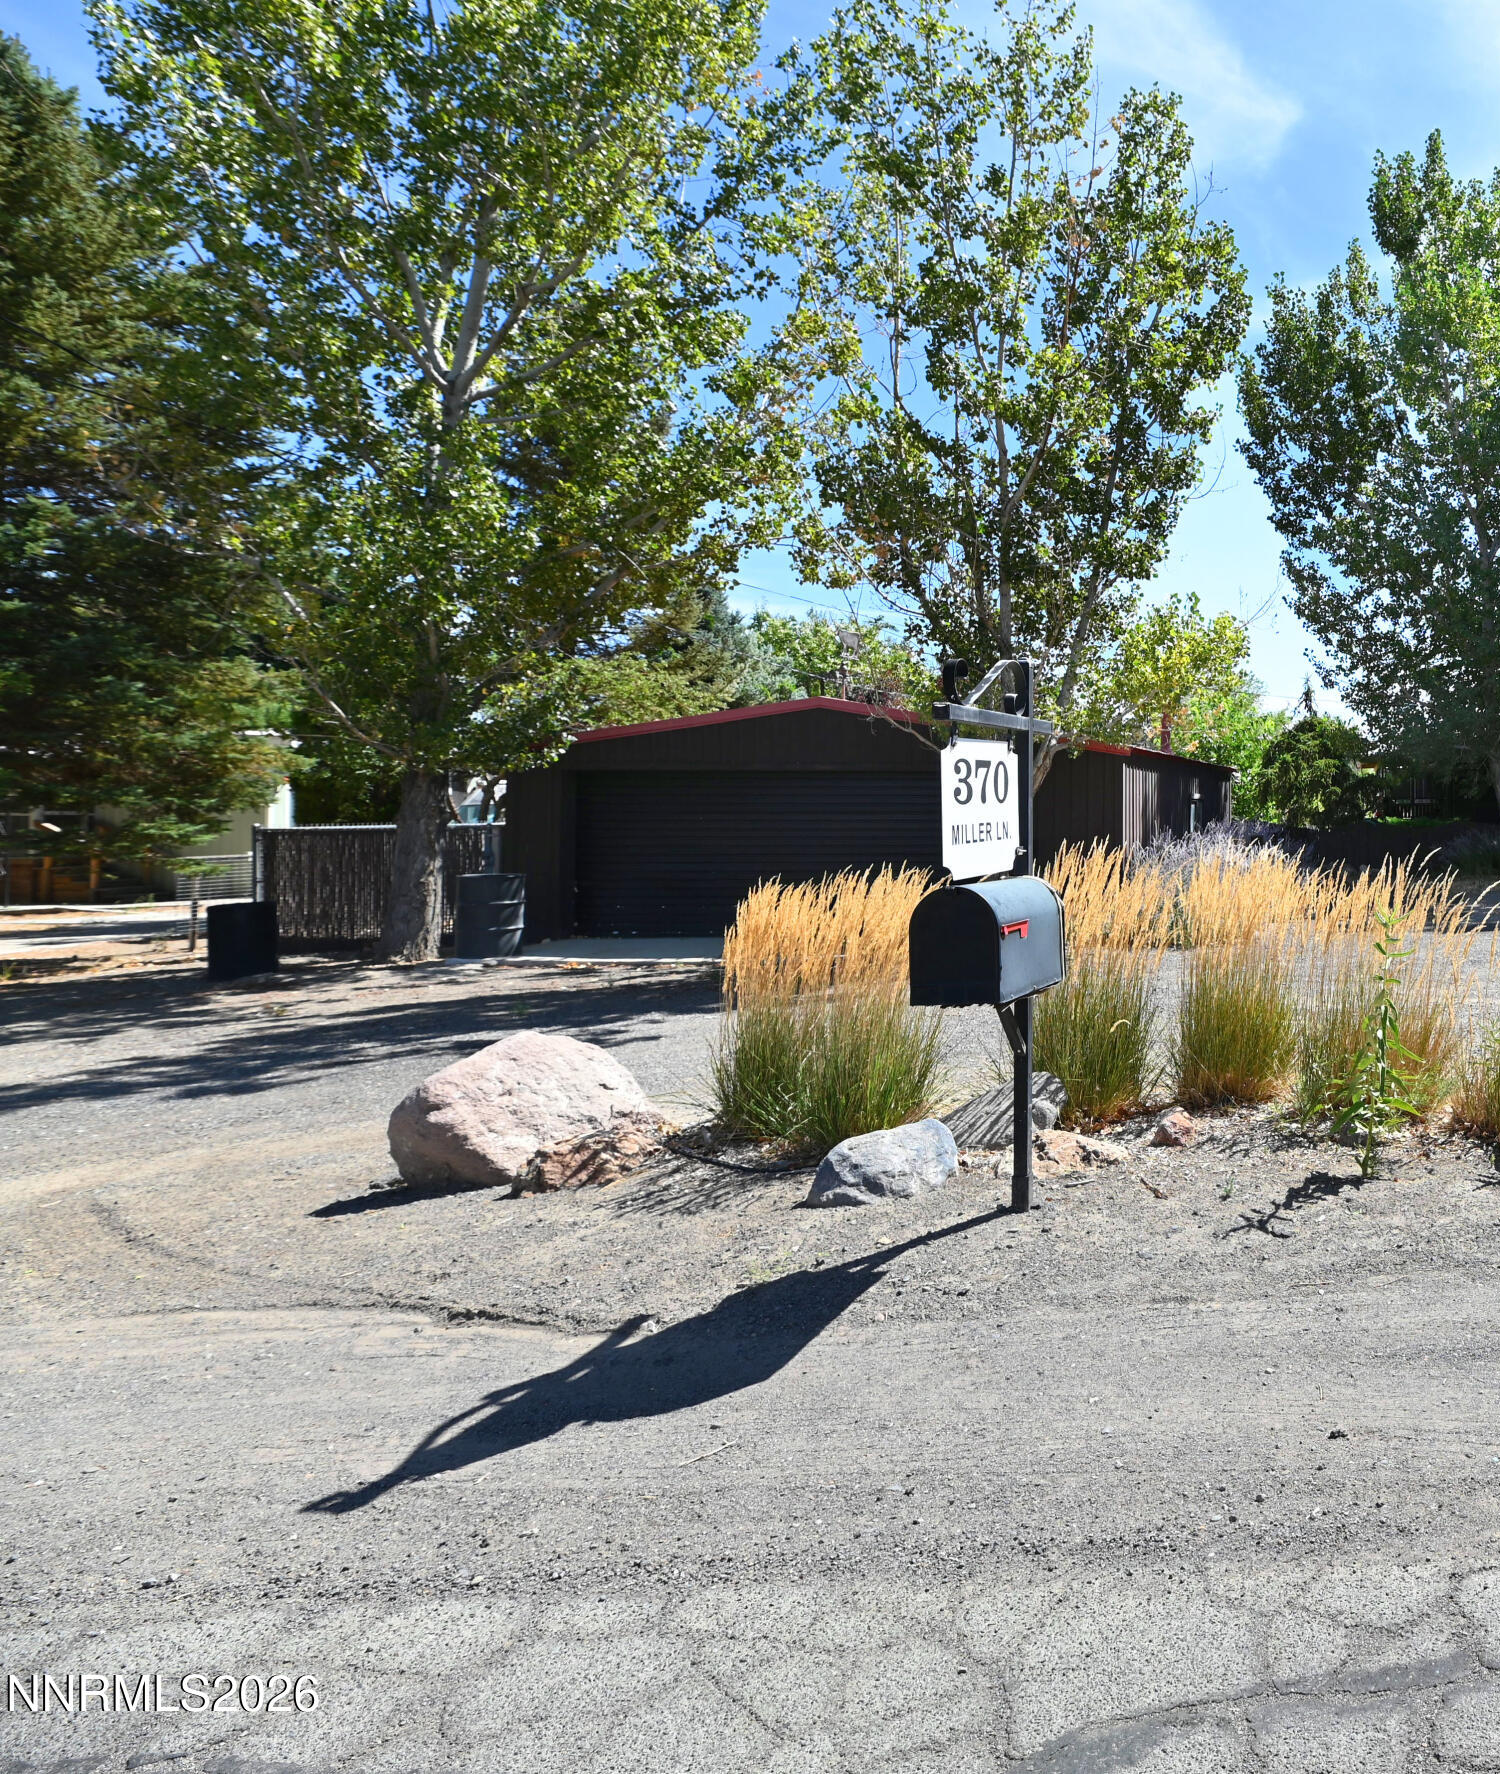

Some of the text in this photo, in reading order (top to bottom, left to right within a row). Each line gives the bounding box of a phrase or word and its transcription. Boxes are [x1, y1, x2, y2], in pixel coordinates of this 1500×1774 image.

[953, 758, 1009, 805] 370
[951, 821, 1012, 846] MILLER LN.
